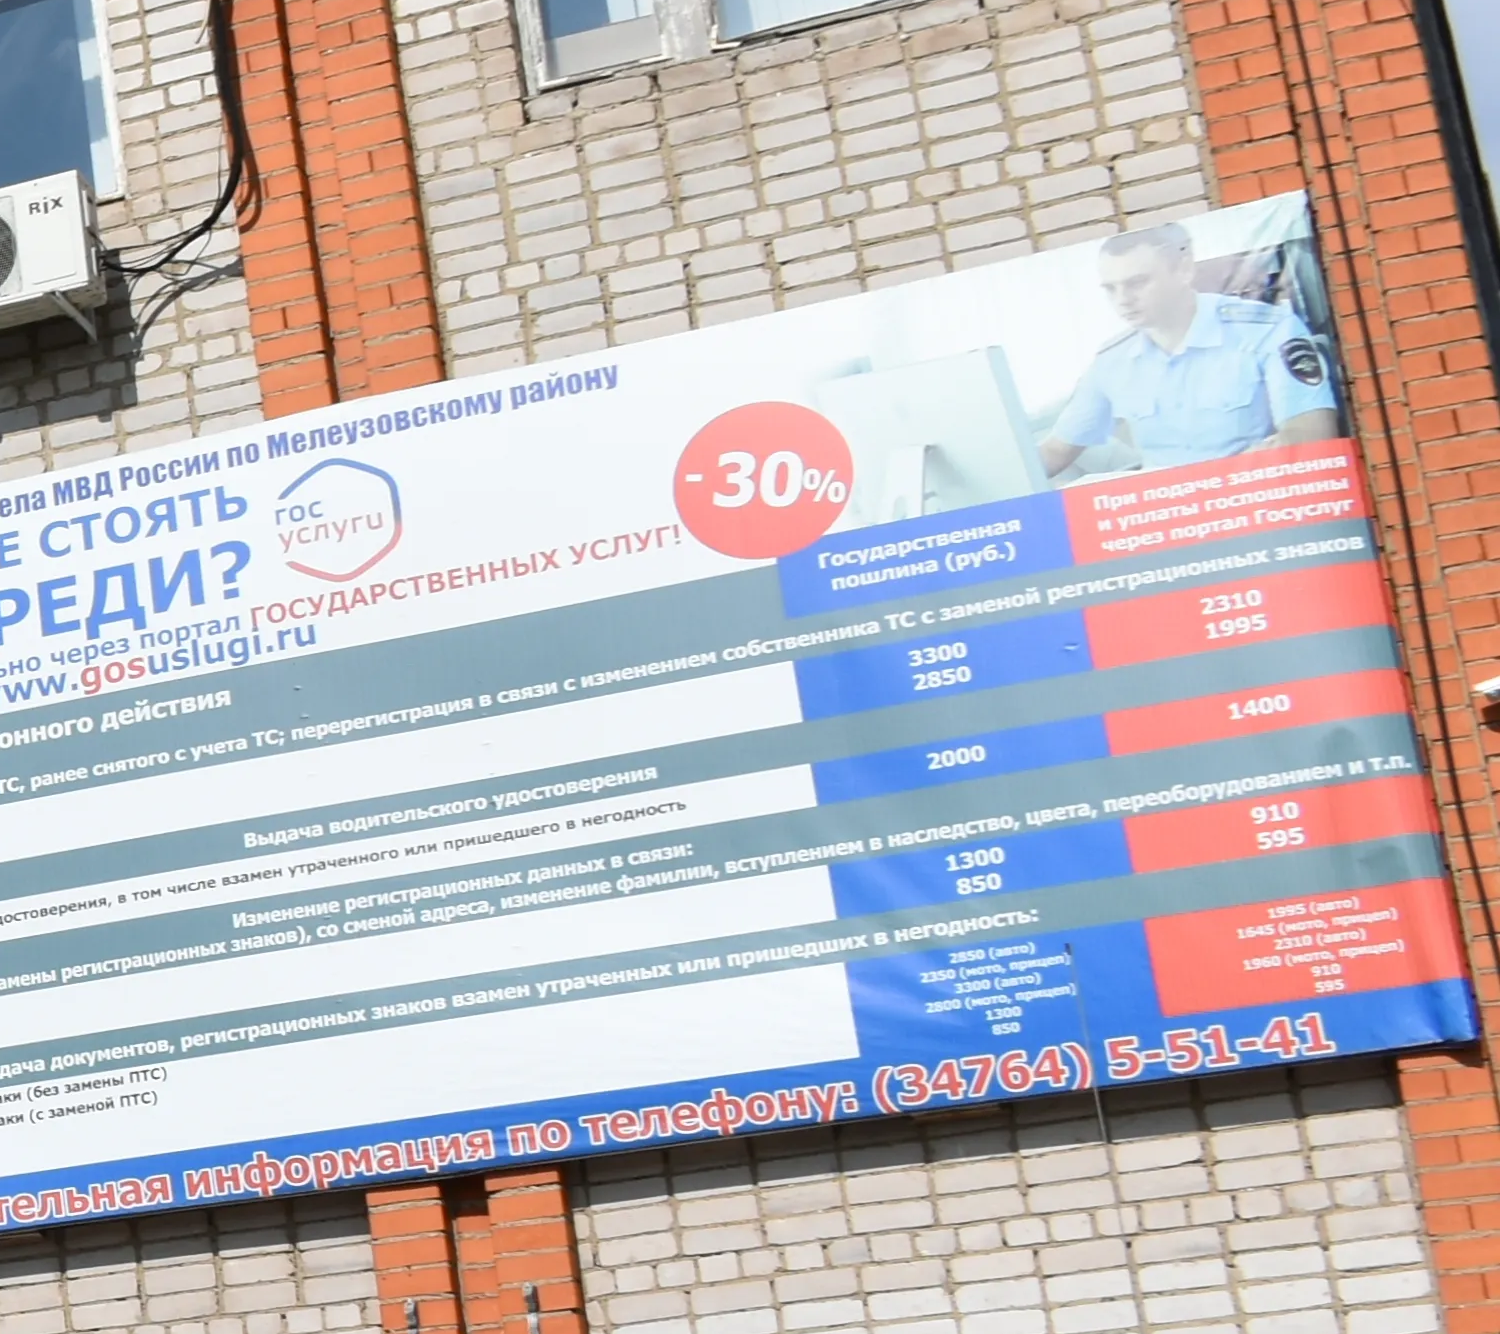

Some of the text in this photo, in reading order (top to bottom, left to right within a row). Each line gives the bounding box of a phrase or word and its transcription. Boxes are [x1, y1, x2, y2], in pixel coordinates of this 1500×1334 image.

[52, 471, 114, 506] МВД
[119, 451, 220, 491] России
[226, 443, 260, 468] по
[267, 390, 501, 459] Мелеузовскому
[510, 365, 617, 410] району
[685, 451, 846, 508] -30%
[1093, 447, 1351, 511] При подаче заявления
[1097, 470, 1356, 531] и уплаты госпошлины
[39, 485, 248, 558] СТОЯТЬ
[275, 501, 324, 525] гос
[278, 512, 383, 554] услуги
[1101, 492, 1360, 552] через портал Госуслуг
[818, 519, 1022, 569] Государственная
[831, 541, 1016, 591] пошлина (руб.)
[50, 637, 130, 665] через
[134, 616, 240, 649] портал
[250, 549, 560, 631] ГОСУДАРСТВЕННЫХ
[568, 524, 681, 565] УСЛУГ!
[1200, 589, 1263, 615] 2310
[1205, 613, 1268, 639] 1995
[30, 767, 88, 792] ранее
[92, 752, 170, 776] снятого
[175, 749, 187, 761] с
[190, 738, 248, 762] учета
[251, 729, 285, 747] ТС;
[291, 698, 474, 740] перерегистрация
[479, 694, 493, 707] в
[497, 682, 558, 703] связи
[563, 678, 576, 691] с
[580, 652, 717, 688] изменением
[722, 621, 881, 661] собственника
[884, 611, 916, 630] ТС
[921, 611, 935, 624] с
[939, 587, 1041, 621] заменой
[1047, 550, 1270, 605] регистрационных
[1274, 527, 1367, 560] знаков
[908, 642, 967, 667] 3300
[912, 666, 972, 690] 2850
[100, 690, 231, 733] действия
[1228, 694, 1291, 720] 1400
[927, 745, 986, 770] 2000
[244, 767, 658, 848] Выдача водительского удостоверения
[1250, 801, 1301, 824] 910
[945, 847, 1005, 871] 1300
[1257, 827, 1305, 850] 595
[232, 843, 694, 928] Изменение регистрационных данных в связи:
[956, 873, 1002, 895] 850
[50, 1039, 175, 1072] документов,
[180, 1009, 367, 1052] регистрационных
[371, 997, 447, 1020] знаков
[452, 985, 530, 1007] взамен
[535, 964, 673, 998] утраченных
[678, 957, 721, 974] или
[727, 935, 868, 969] пришедших
[873, 932, 889, 945] в
[894, 909, 1039, 942] негодность:
[27, 1085, 59, 1102] (без
[64, 1076, 124, 1094] замены
[129, 1067, 167, 1083] ПТС)
[183, 1129, 496, 1200] информация
[506, 1119, 572, 1156] по
[579, 1081, 859, 1145] телефону:
[872, 1042, 1093, 1112] (34764)
[1104, 1012, 1336, 1079] 5-51-41
